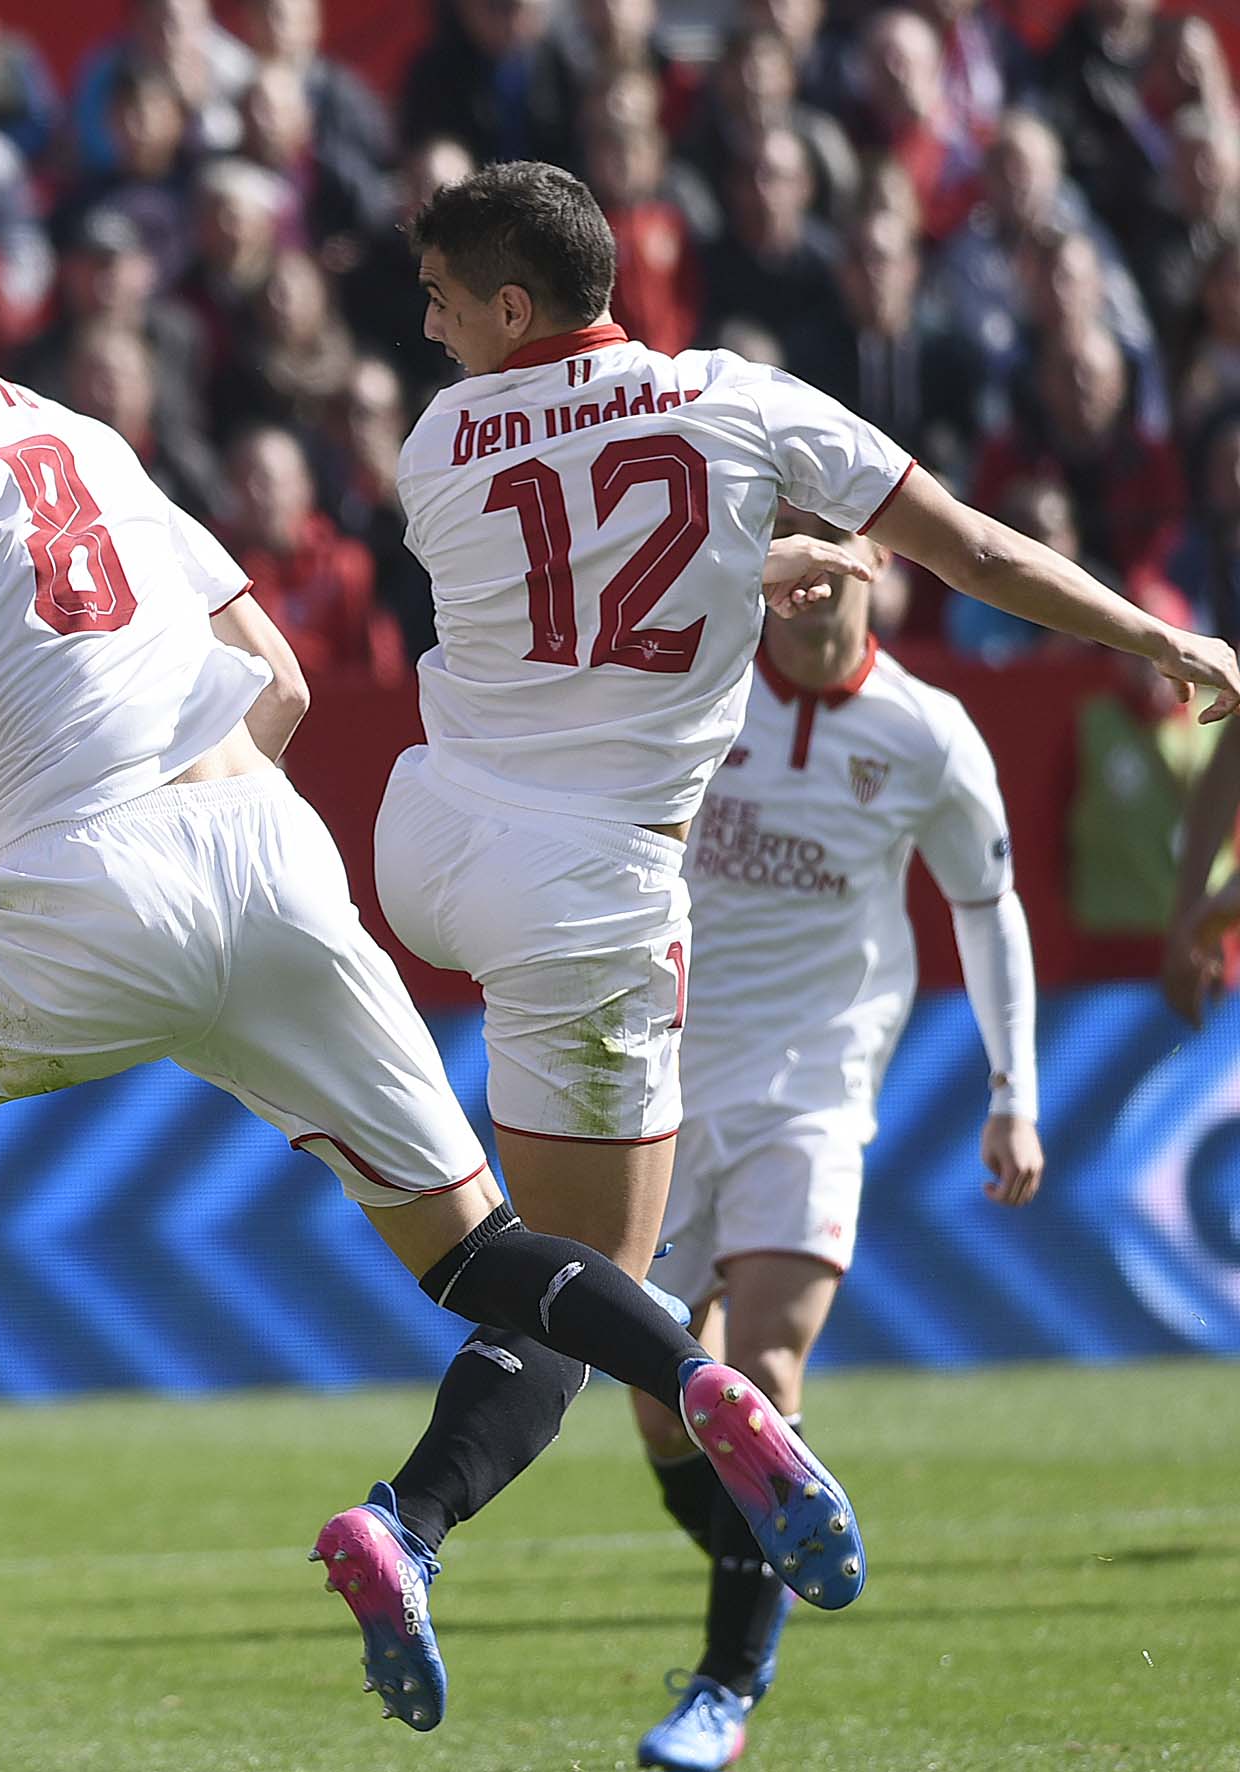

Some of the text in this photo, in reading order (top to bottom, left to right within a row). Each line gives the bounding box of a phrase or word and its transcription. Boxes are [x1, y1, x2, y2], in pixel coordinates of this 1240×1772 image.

[451, 410, 531, 466] ben
[482, 433, 710, 673] 12
[701, 816, 825, 865] PUERTO
[396, 1561, 421, 1635] adidas
